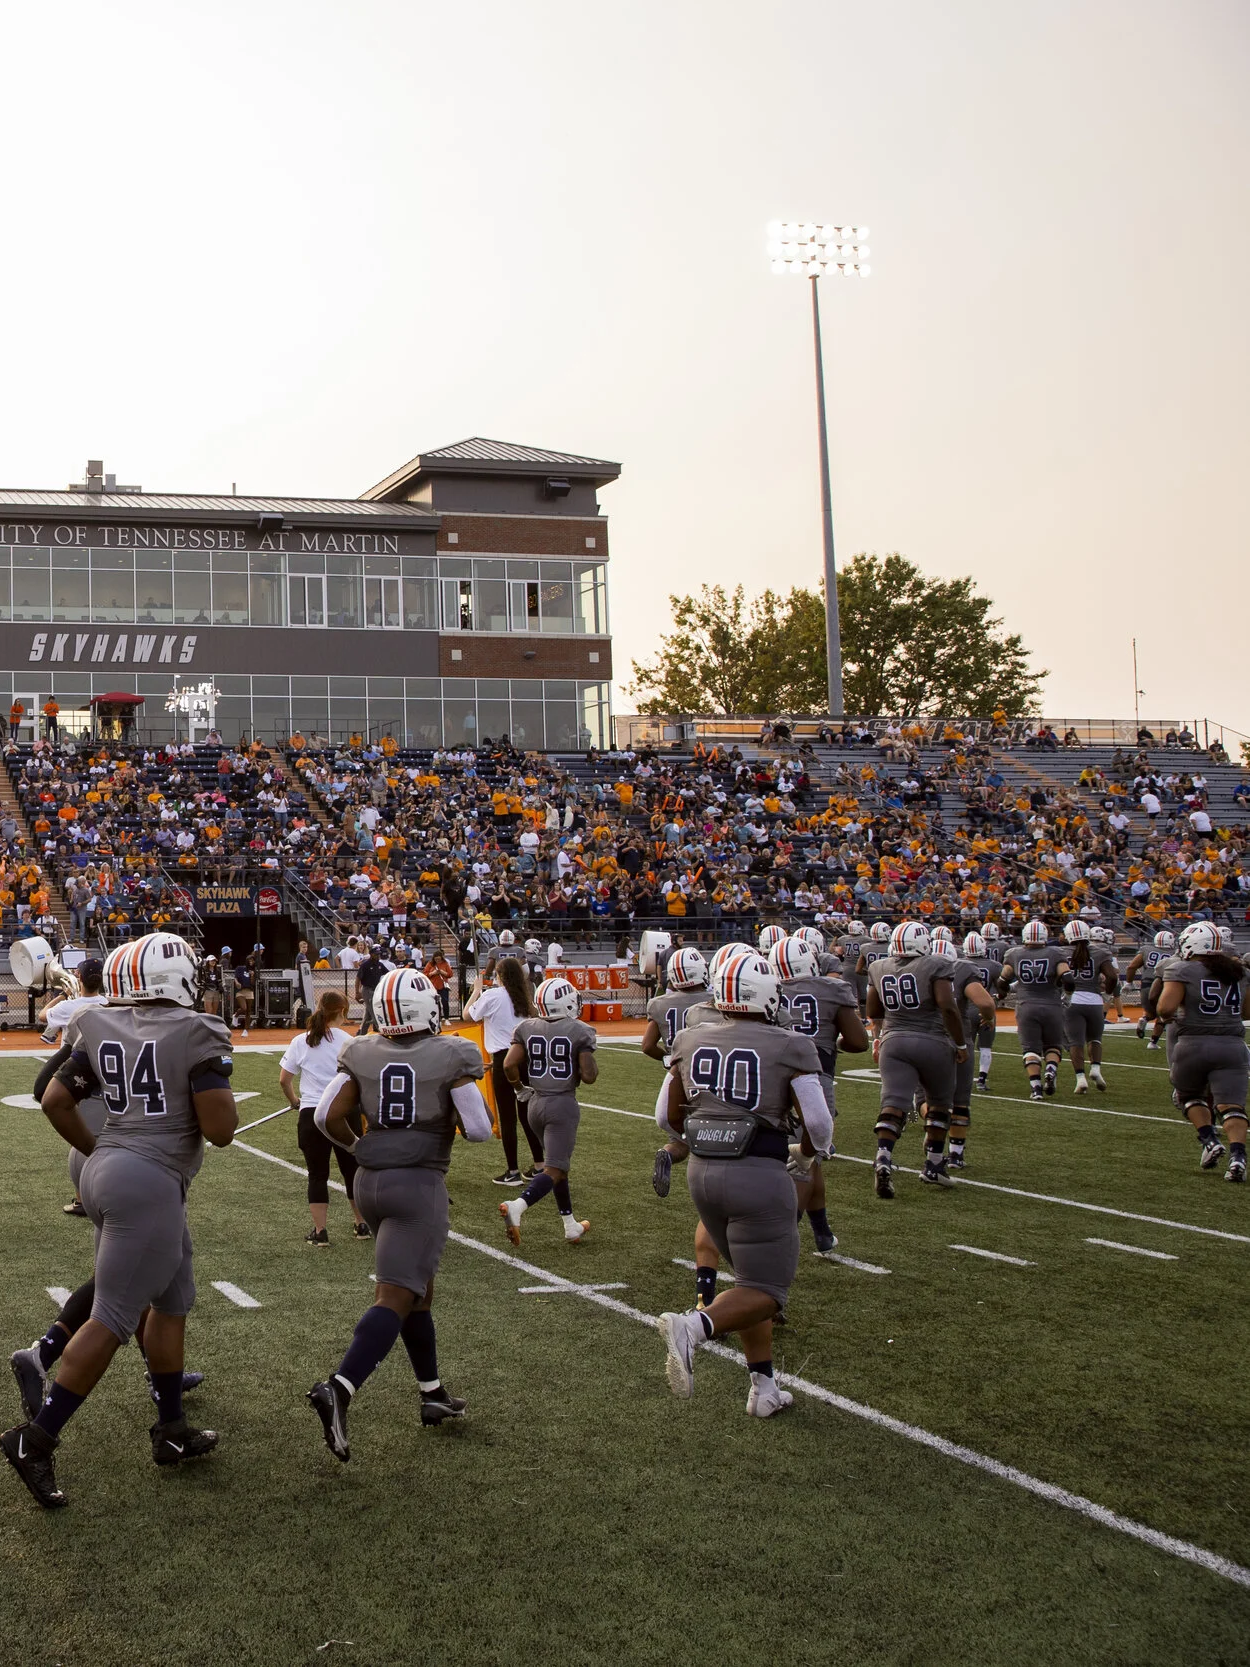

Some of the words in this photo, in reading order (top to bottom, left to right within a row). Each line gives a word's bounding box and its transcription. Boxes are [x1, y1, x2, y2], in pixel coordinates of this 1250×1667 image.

[54, 525, 87, 546] OF
[98, 527, 247, 550] TENNESSEE
[260, 531, 289, 551] AT
[300, 532, 399, 554] MARTIN
[28, 632, 198, 665] SKYHAWKS
[196, 886, 251, 900] SKYHAWK
[206, 901, 241, 914] PLAZA
[845, 943, 861, 958] 79
[1018, 958, 1050, 984] 67
[880, 972, 921, 1012] 68
[1199, 979, 1242, 1015] 54
[607, 1005, 614, 1014] G
[718, 1003, 749, 1012] Riddell
[382, 1025, 414, 1035] Riddell
[527, 1034, 573, 1081] 89
[97, 1039, 168, 1116] 94
[690, 1046, 761, 1112] 90
[378, 1062, 416, 1129] 8
[696, 1128, 738, 1144] DOUGLAS
